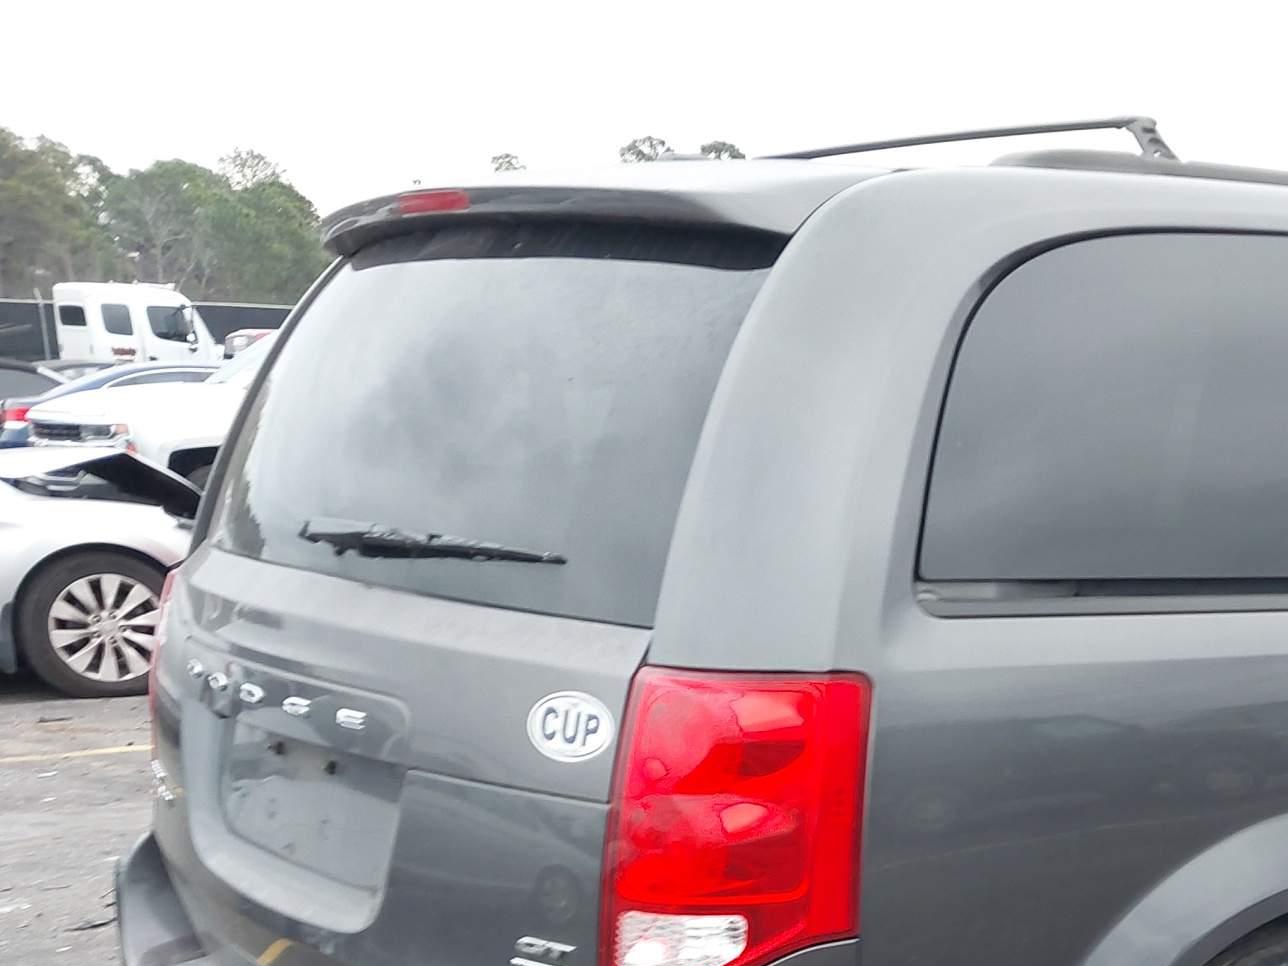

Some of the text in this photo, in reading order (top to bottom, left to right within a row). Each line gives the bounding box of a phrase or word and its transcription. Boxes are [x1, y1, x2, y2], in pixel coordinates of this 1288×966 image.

[186, 657, 368, 731] DODGE
[541, 706, 601, 748] CUP
[514, 935, 578, 960] GT
